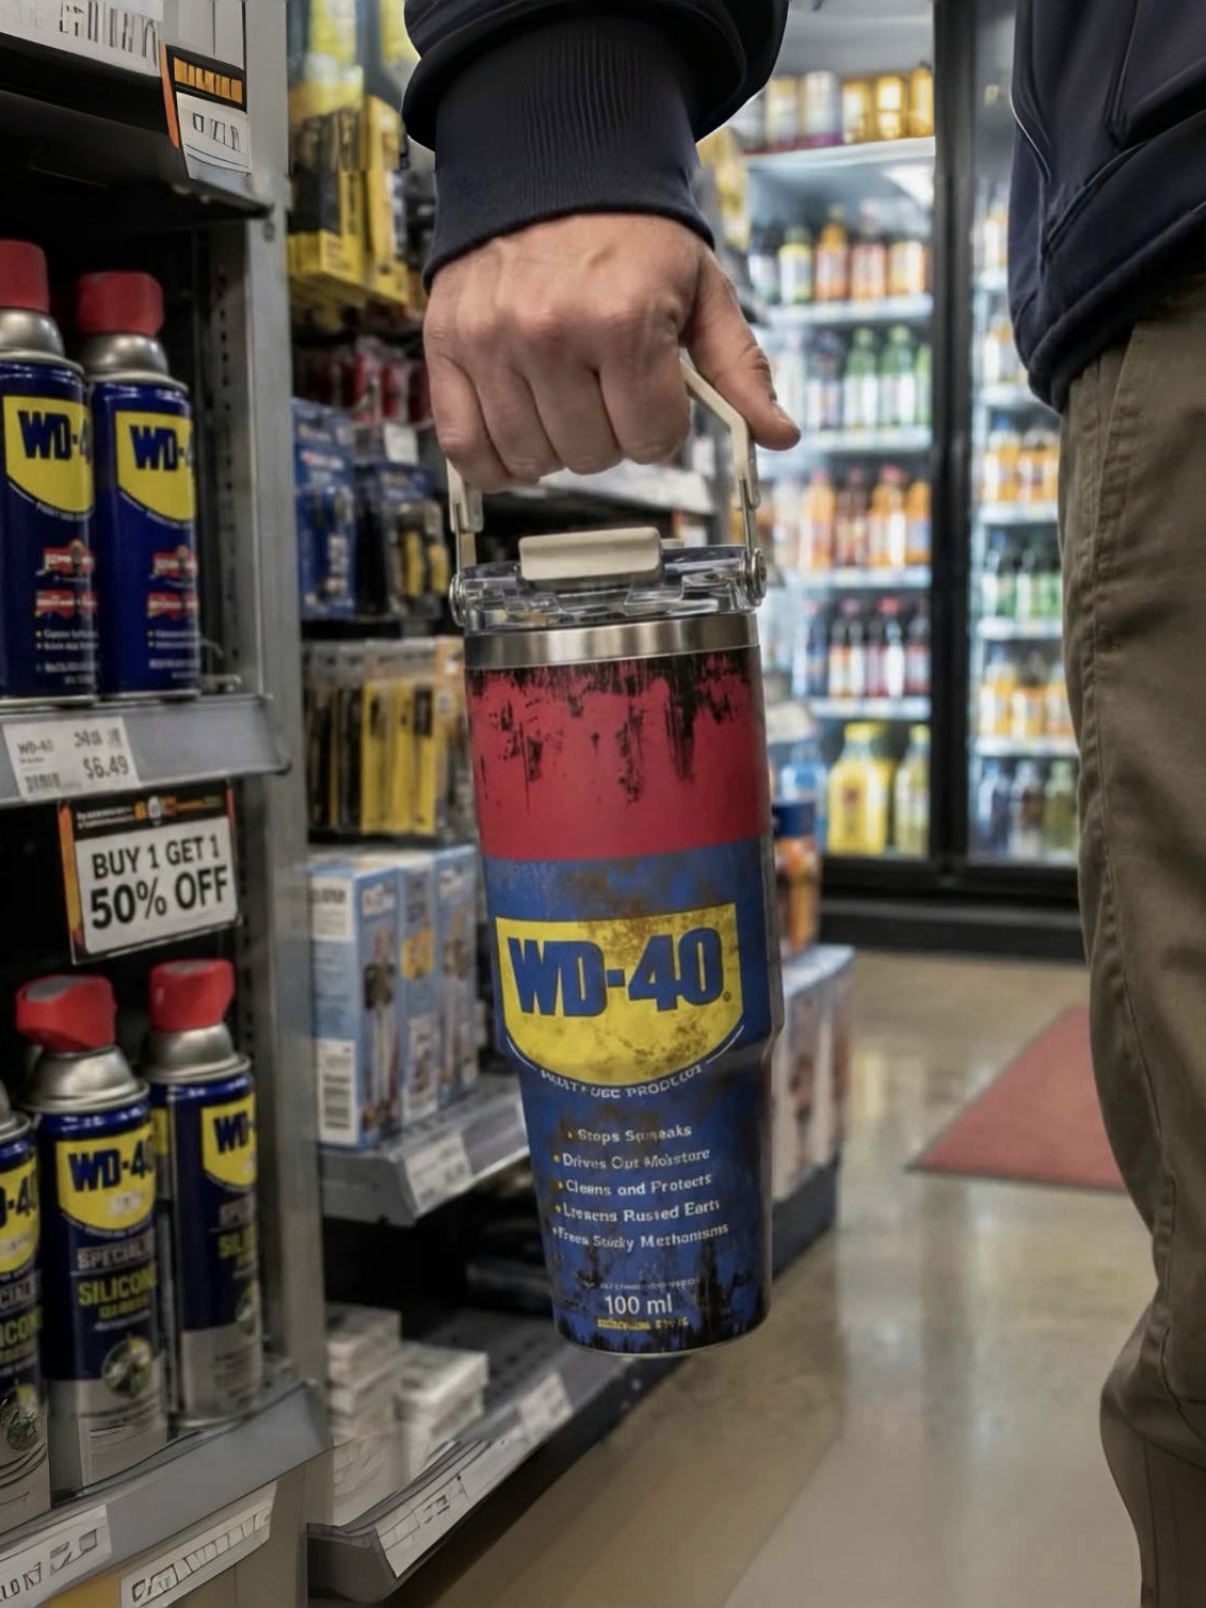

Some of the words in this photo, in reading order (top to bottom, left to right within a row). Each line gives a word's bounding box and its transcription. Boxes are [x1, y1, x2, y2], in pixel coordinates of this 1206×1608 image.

[83, 755, 129, 779] $6.49
[91, 846, 140, 880] BUY
[147, 844, 160, 869] 1
[165, 836, 204, 866] GET
[209, 834, 220, 859] 1
[91, 877, 167, 929] 50%
[175, 865, 228, 910] OFF
[507, 927, 724, 1017] WD-40
[68, 1138, 153, 1192] WD-4
[617, 1183, 646, 1196] and
[651, 1173, 713, 1194] Protects
[604, 1295, 640, 1315] 100
[647, 1292, 673, 1315] ml
